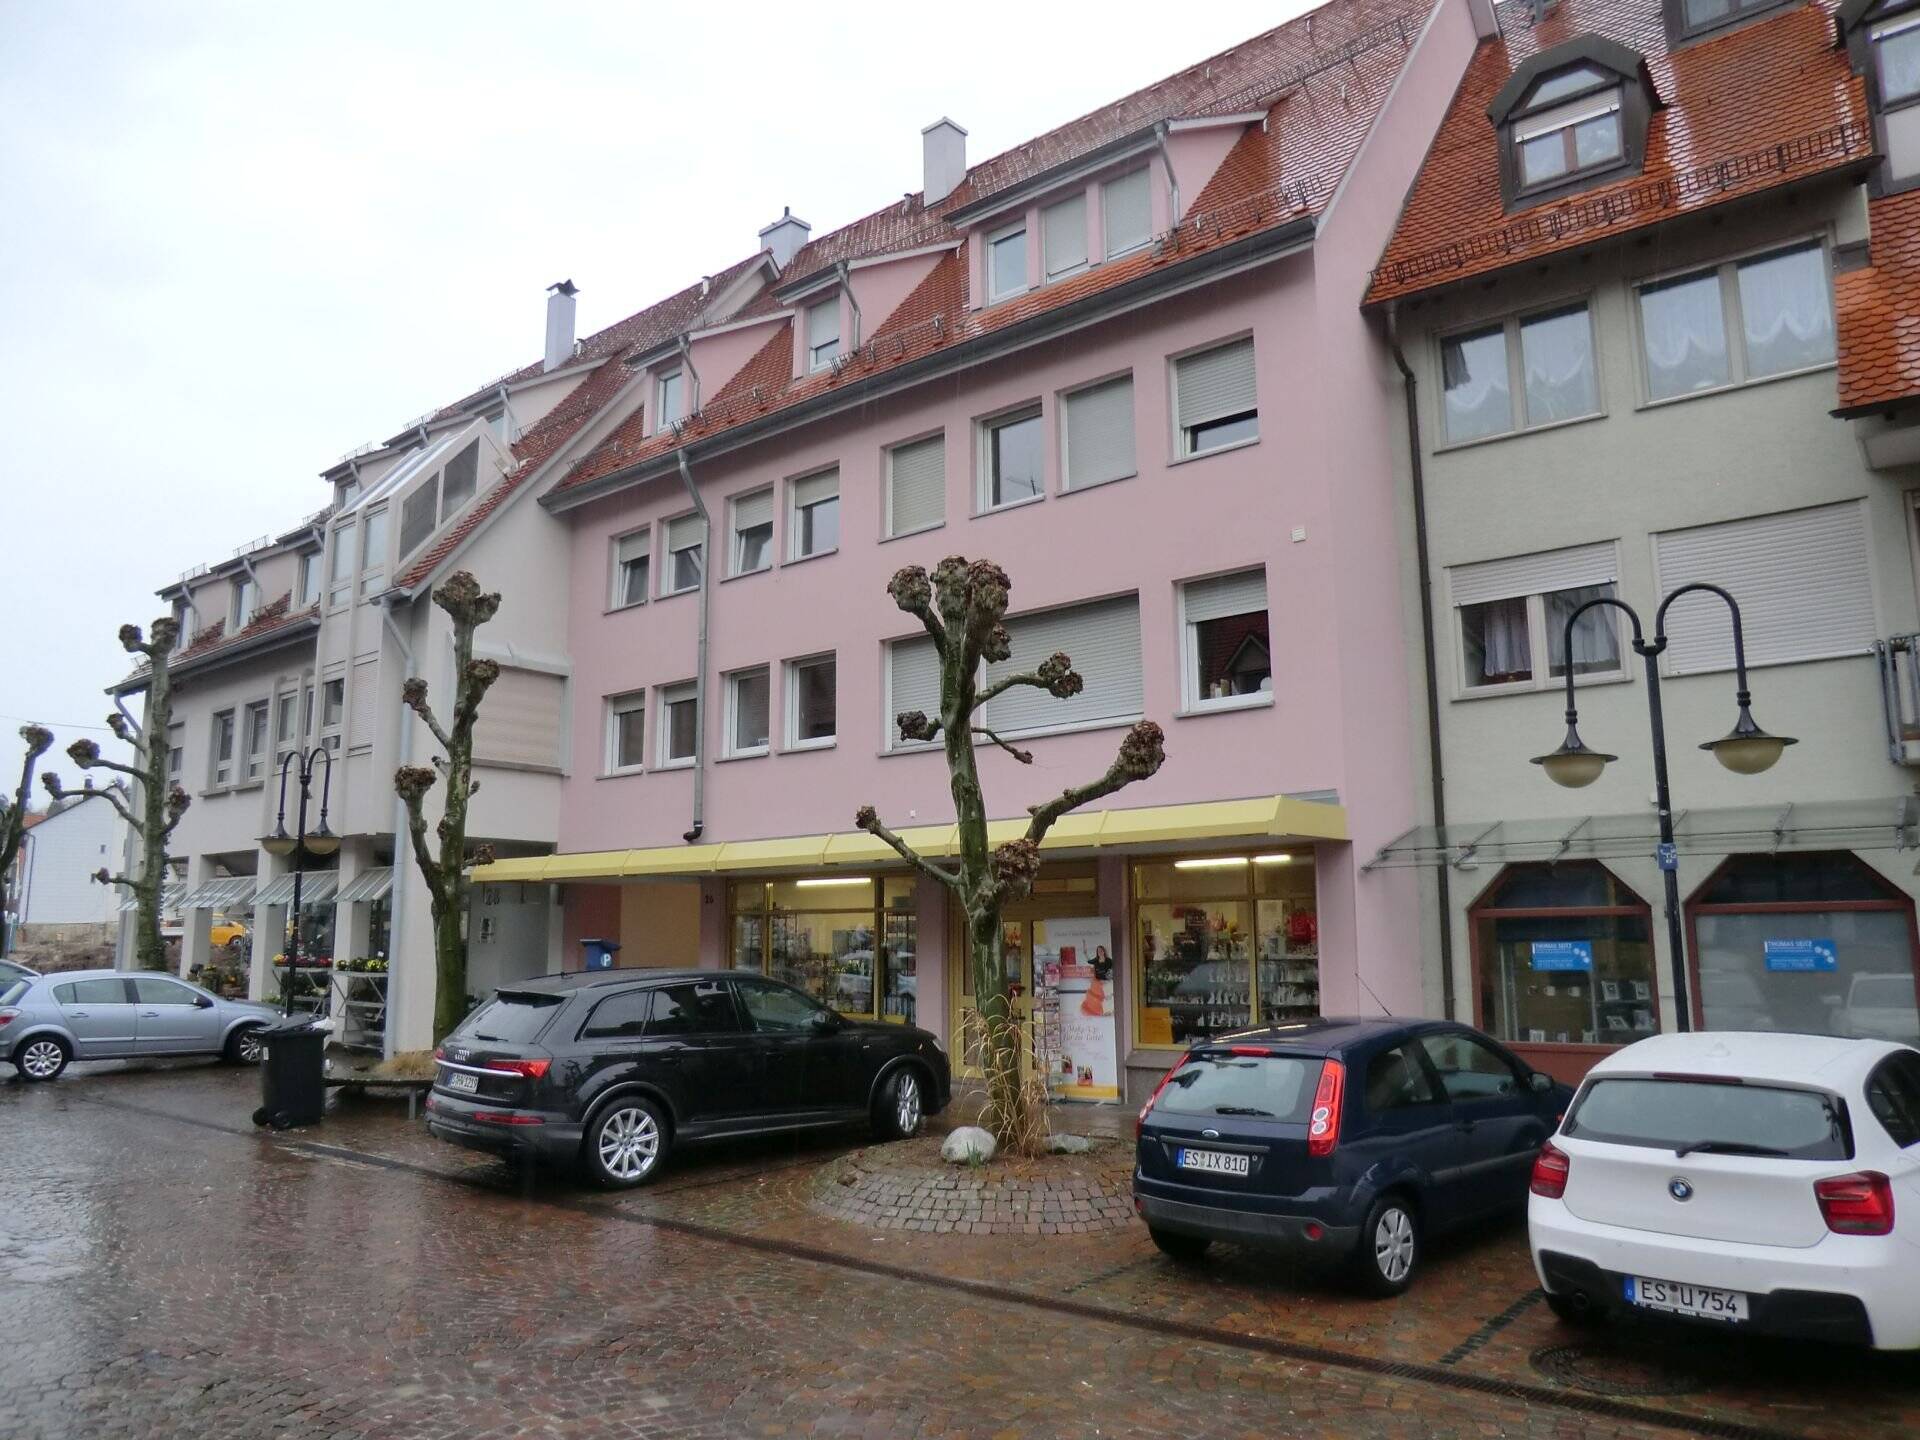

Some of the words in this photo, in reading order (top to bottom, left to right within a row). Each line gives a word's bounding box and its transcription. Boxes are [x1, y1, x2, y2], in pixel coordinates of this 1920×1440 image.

[1183, 1151, 1199, 1167] ES
[1223, 1155, 1247, 1173] 810
[1641, 1281, 1667, 1302] ES
[1680, 1286, 1694, 1307] U
[1698, 1290, 1738, 1314] 754
